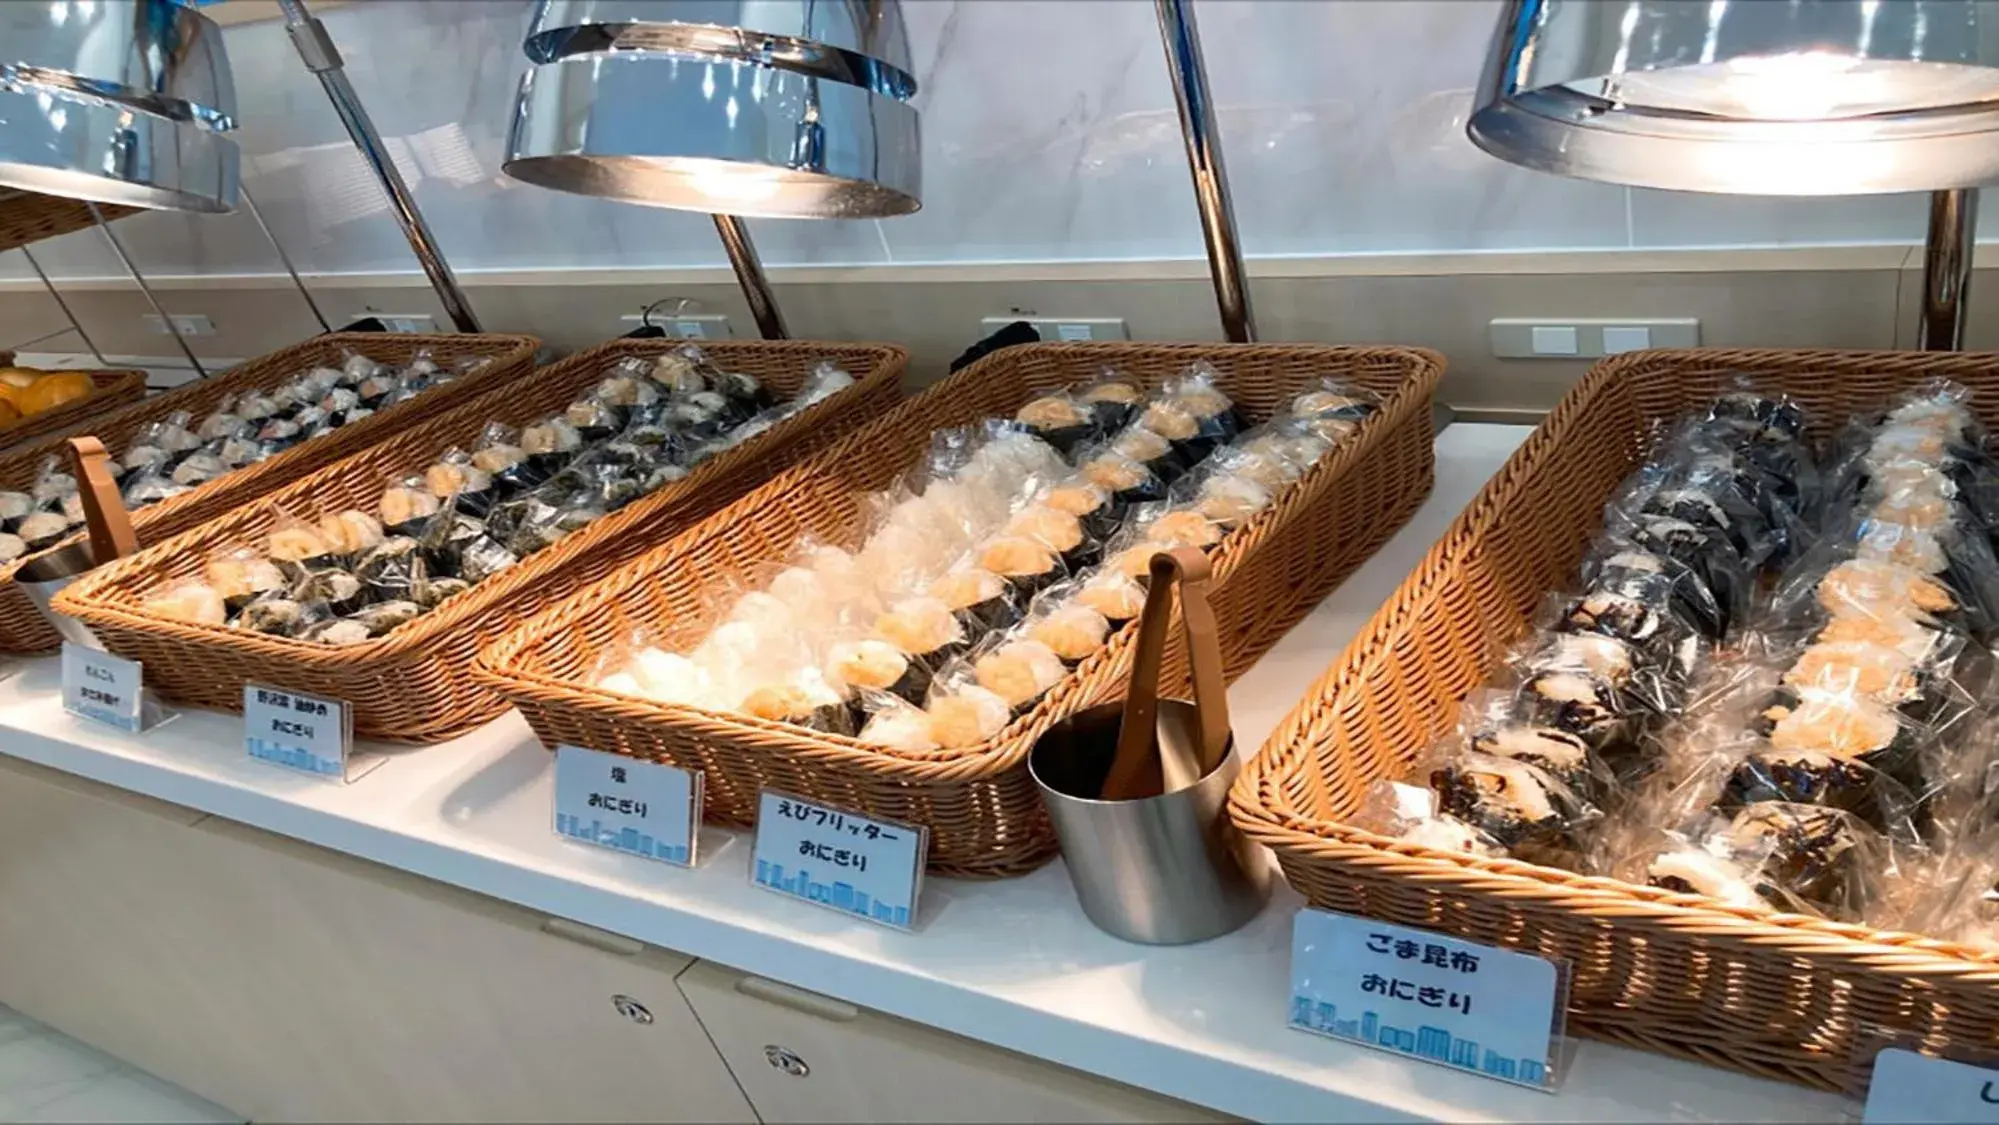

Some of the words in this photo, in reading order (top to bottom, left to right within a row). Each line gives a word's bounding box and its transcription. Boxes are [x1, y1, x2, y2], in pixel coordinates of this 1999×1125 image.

[272, 719, 314, 739] おにぎり
[611, 766, 627, 784] 塩
[588, 792, 647, 818] おにぎり
[778, 800, 898, 841] えびフリッター
[799, 840, 867, 872] おにぎり
[1366, 933, 1480, 973] ごま昆布
[1361, 974, 1471, 1015] おにぎり
